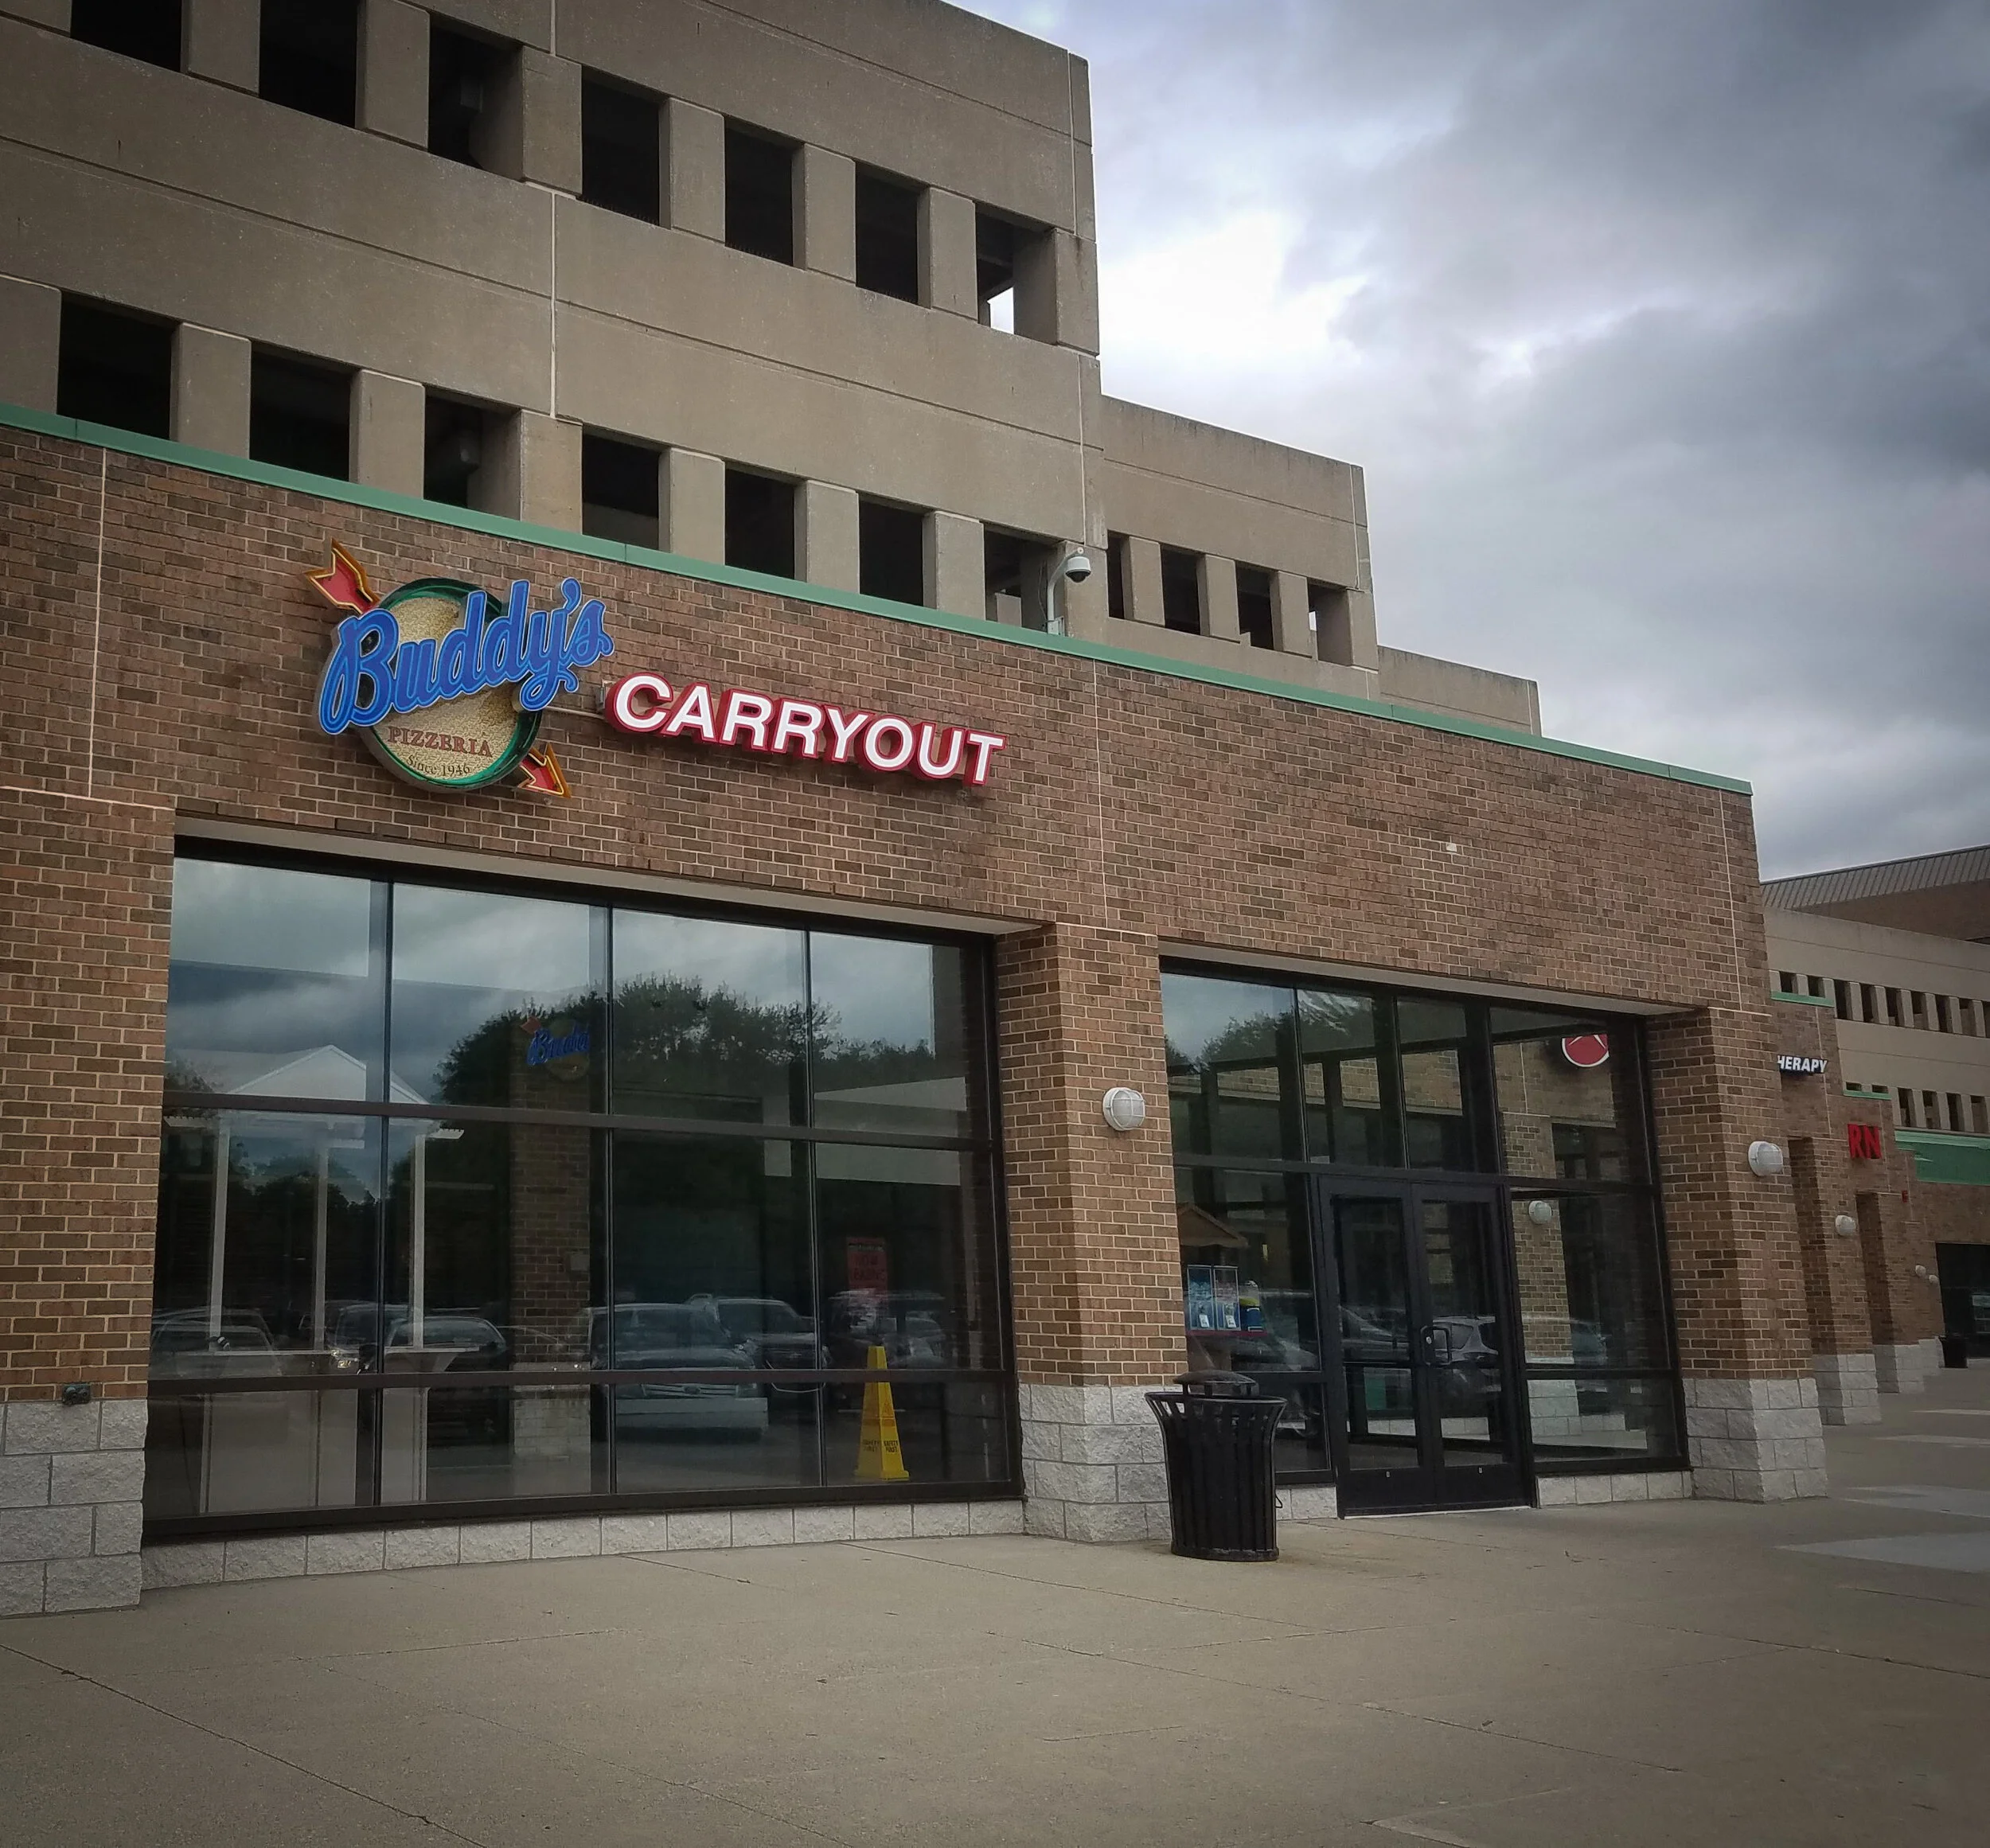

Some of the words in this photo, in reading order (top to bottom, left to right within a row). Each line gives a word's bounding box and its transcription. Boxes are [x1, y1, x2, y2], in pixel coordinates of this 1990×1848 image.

[319, 579, 614, 735] Buddy's
[388, 726, 493, 758] PIZZERIA
[406, 754, 438, 776] Since
[442, 762, 470, 777] 1946
[611, 674, 1006, 786] CARRYOUT
